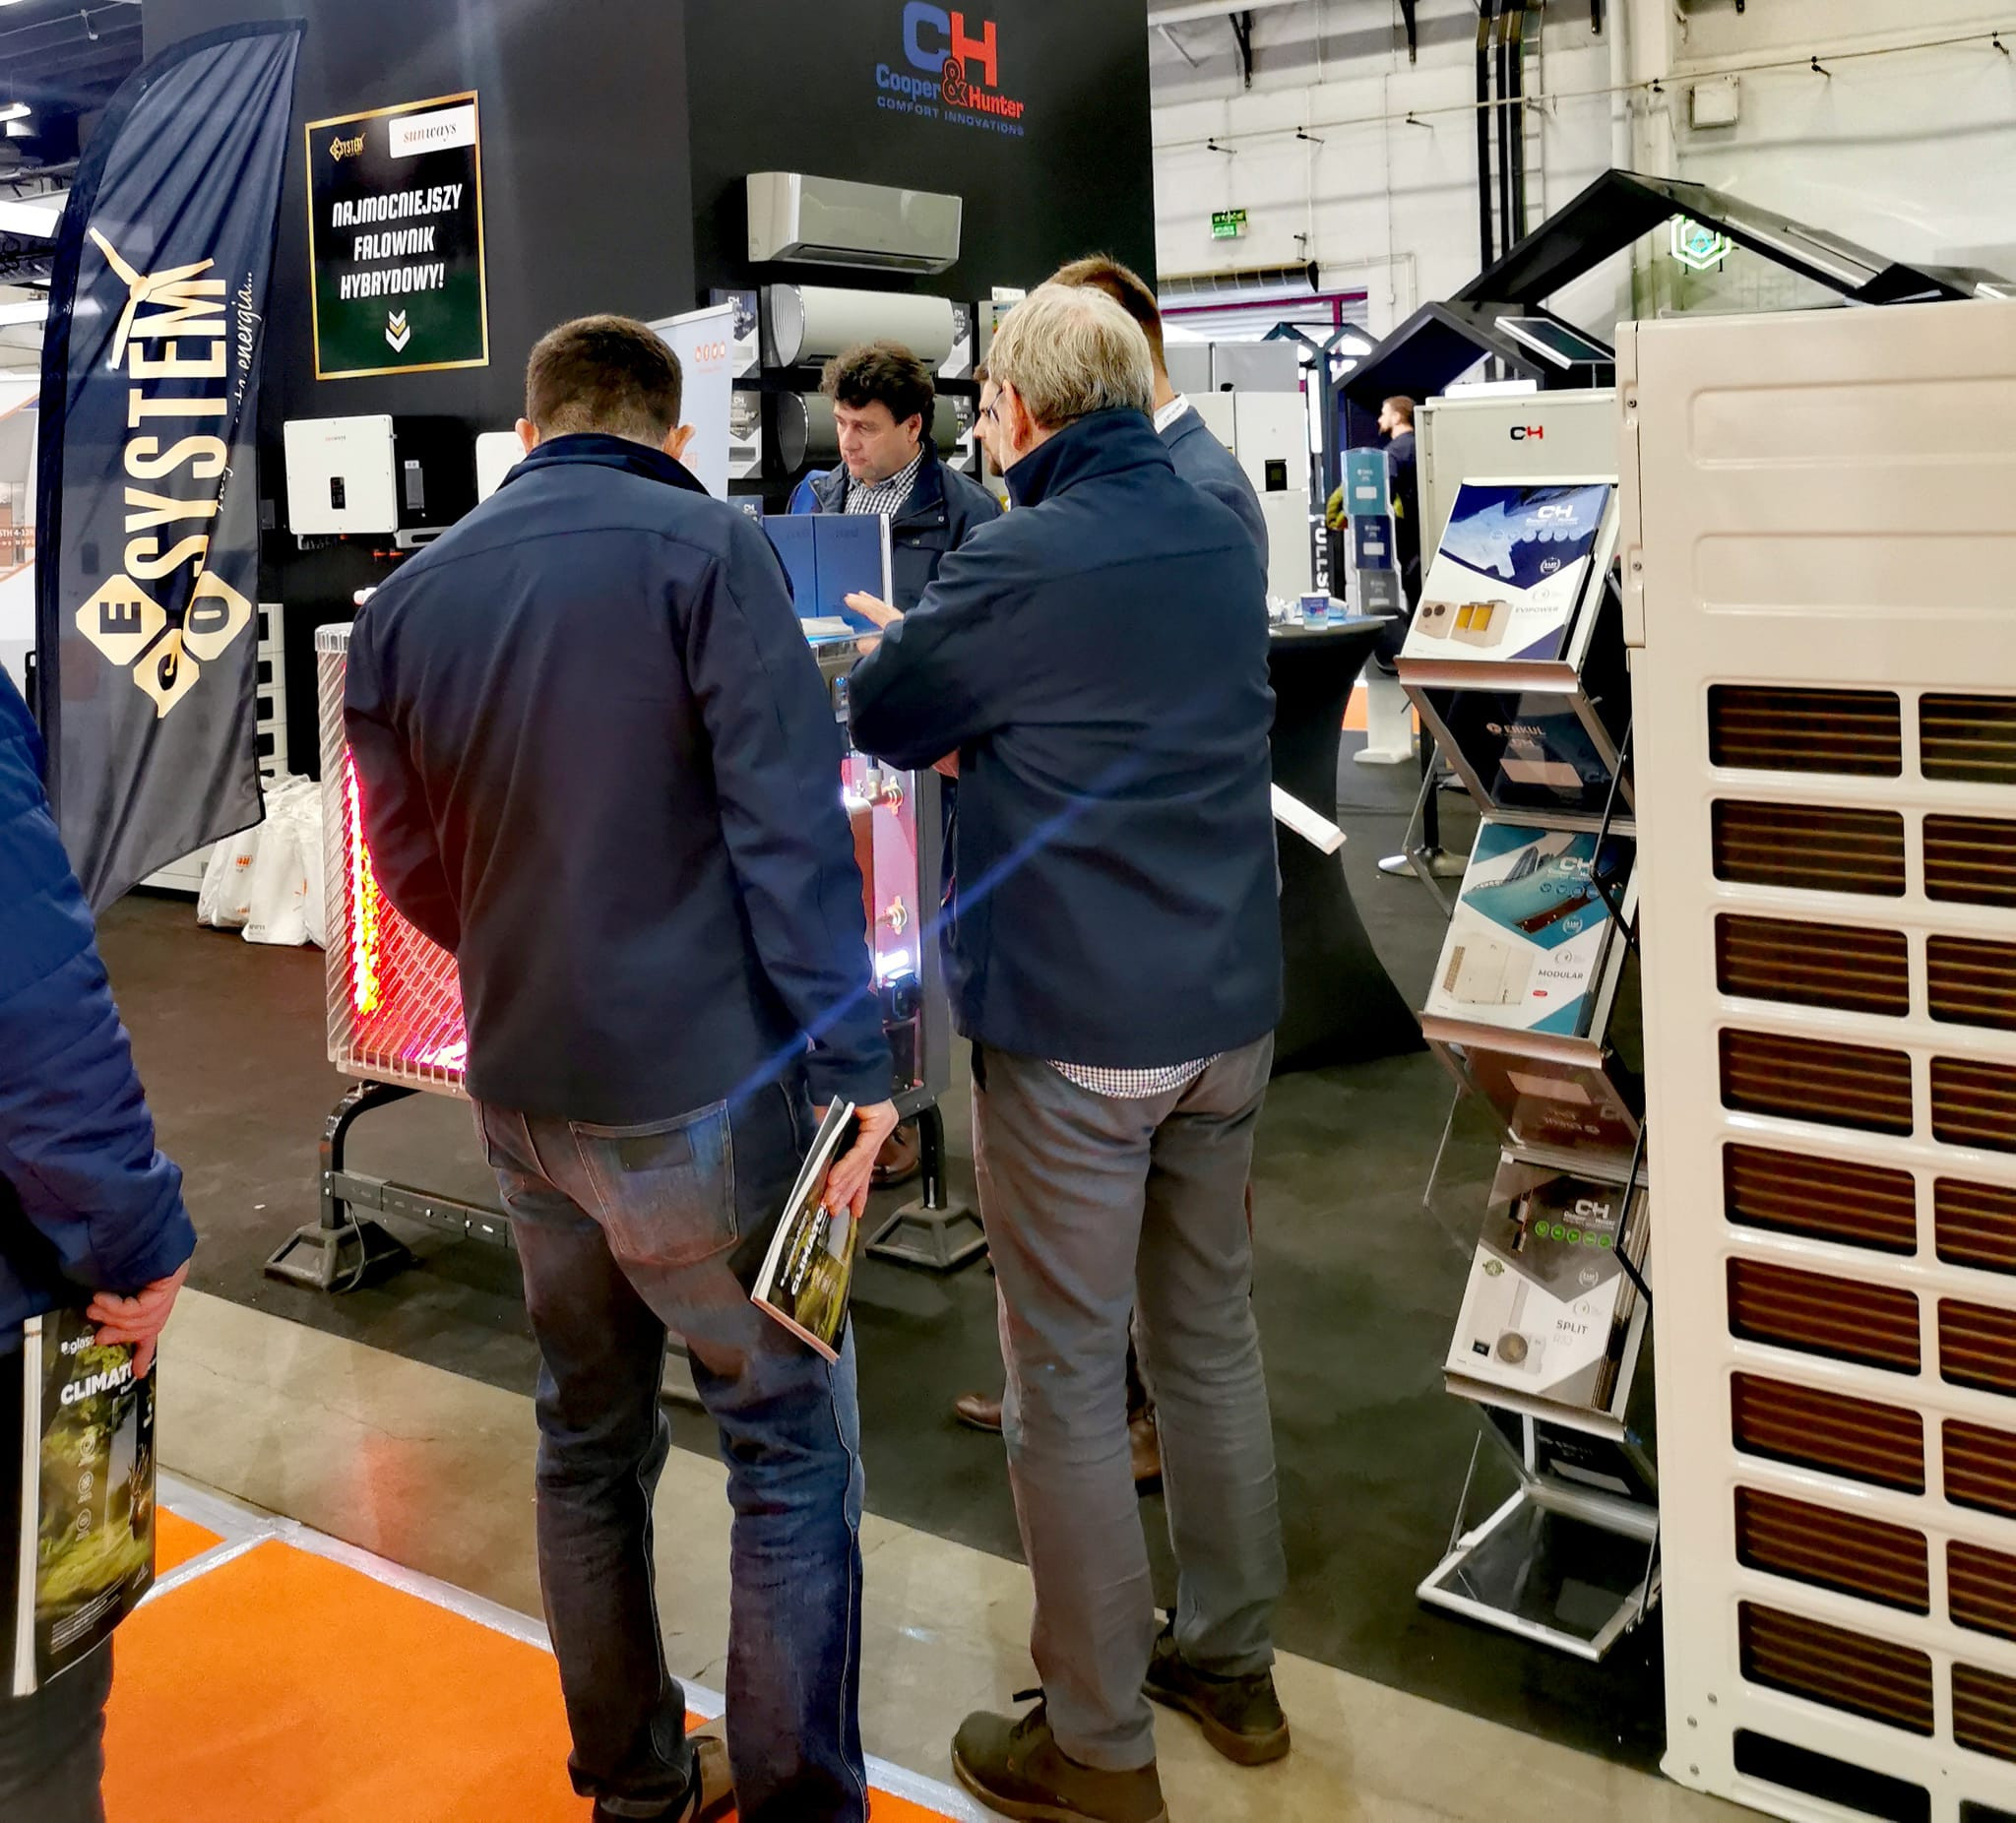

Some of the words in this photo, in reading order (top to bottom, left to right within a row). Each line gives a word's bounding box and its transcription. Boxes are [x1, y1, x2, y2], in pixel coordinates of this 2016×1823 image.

[903, 0, 998, 88] CH
[876, 62, 941, 102] Cooper
[969, 85, 1025, 119] Hunter
[403, 122, 457, 143] sunways
[877, 95, 940, 119] COMFORT
[944, 110, 1025, 137] INNOVATIONS
[332, 183, 463, 228] NAJMOCNIEJSZY
[353, 225, 435, 262] FALOWNIK
[340, 262, 445, 300] HYBRYDOWY!
[124, 278, 228, 580] SYSTEM
[1510, 425, 1544, 440] CH
[1538, 504, 1573, 519] CH
[1314, 514, 1330, 597] FULLS
[1538, 969, 1584, 980] MODULAR
[1575, 1199, 1610, 1219] CH
[790, 1200, 825, 1296] CLIMATO
[1556, 1319, 1589, 1335] SPLIT
